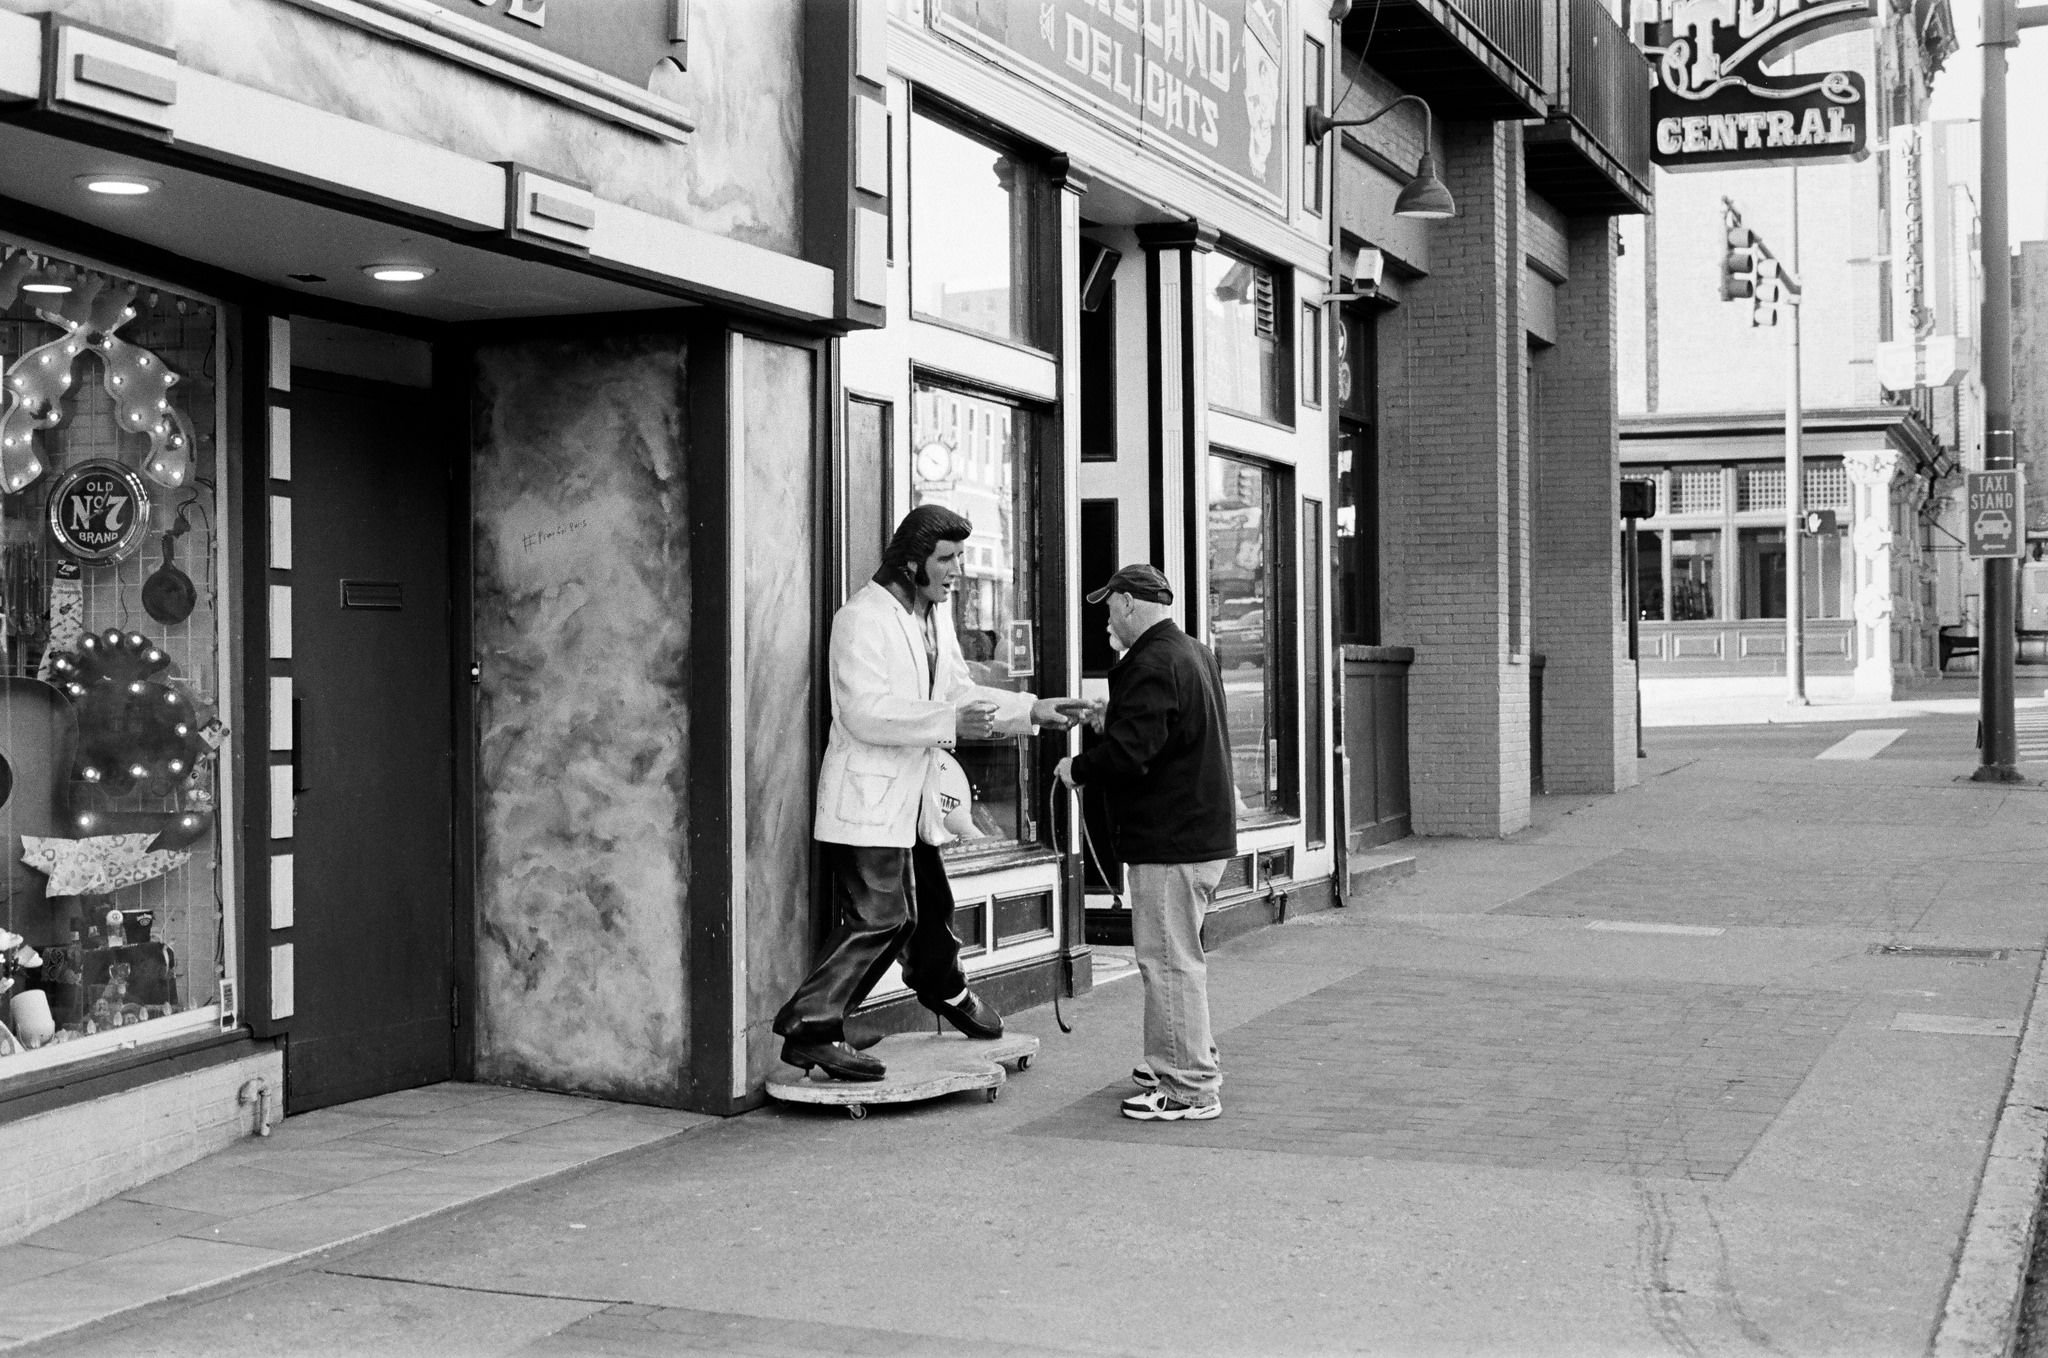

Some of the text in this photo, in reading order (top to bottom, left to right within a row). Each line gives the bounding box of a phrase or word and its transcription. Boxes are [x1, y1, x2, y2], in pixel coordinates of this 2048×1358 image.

[1065, 12, 1219, 148] DELIGHTS
[1657, 106, 1855, 155] CENTRAL
[86, 481, 114, 492] OLD
[1979, 475, 2008, 492] TAXI
[1970, 492, 2014, 510] STAND
[79, 531, 119, 544] BRAND
